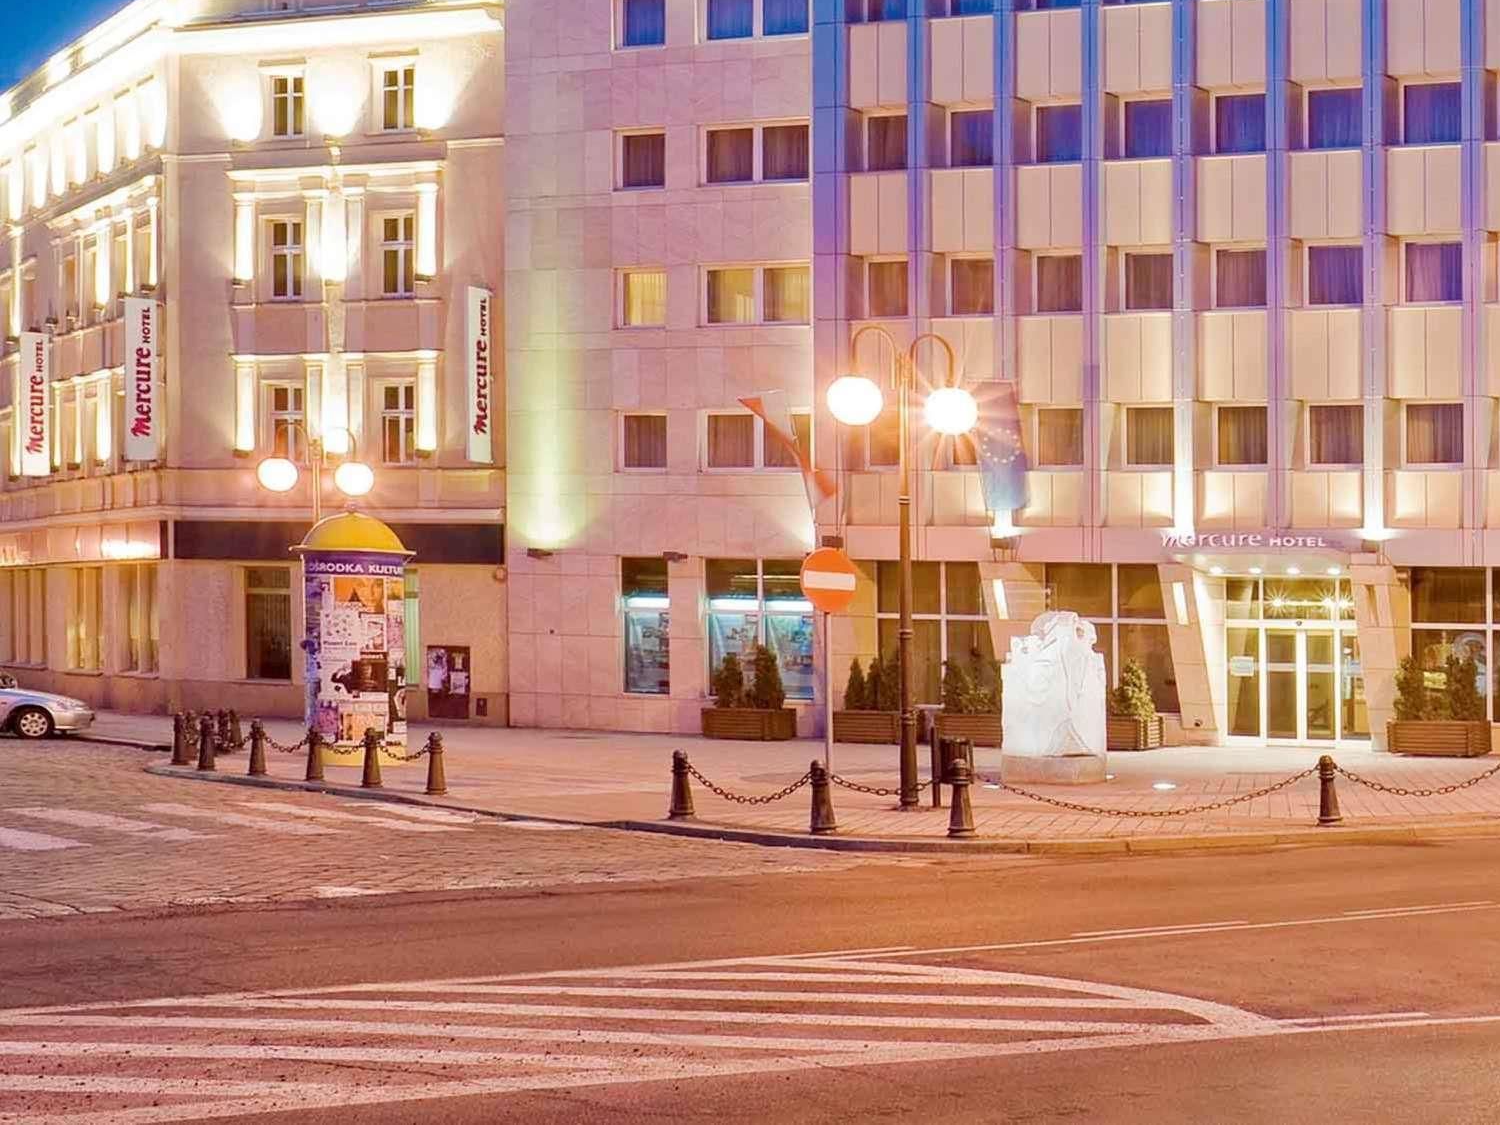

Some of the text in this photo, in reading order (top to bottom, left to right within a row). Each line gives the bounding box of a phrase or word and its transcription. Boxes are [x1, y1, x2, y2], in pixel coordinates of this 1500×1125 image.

[142, 307, 151, 343] HOTEL
[36, 339, 44, 372] HOTEL
[1269, 536, 1327, 547] HOTEL
